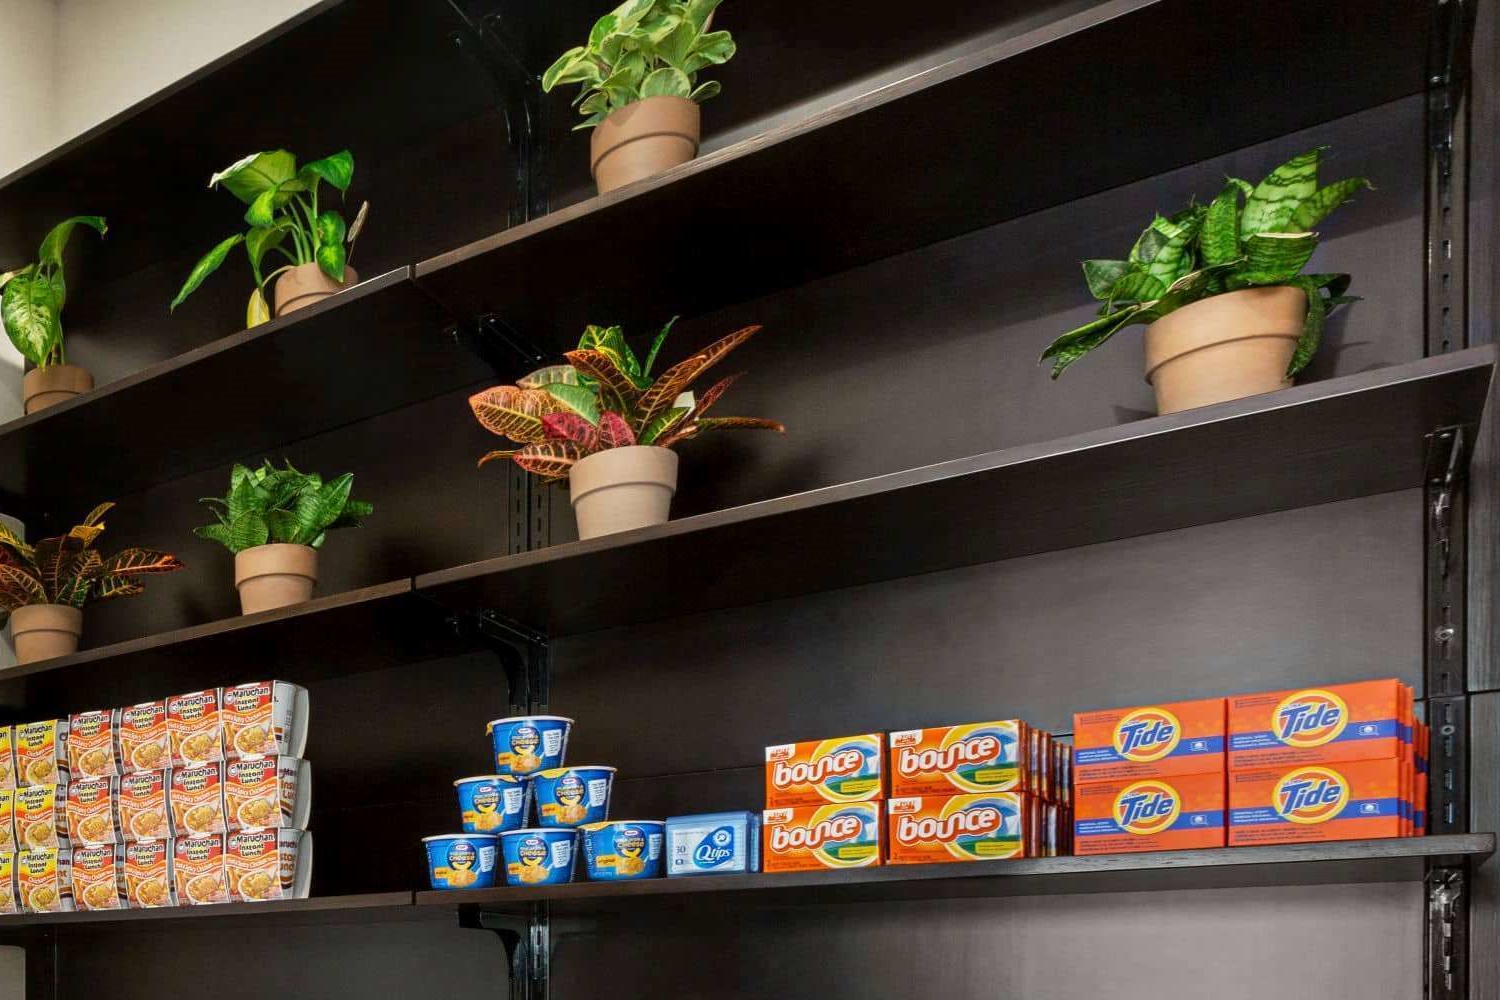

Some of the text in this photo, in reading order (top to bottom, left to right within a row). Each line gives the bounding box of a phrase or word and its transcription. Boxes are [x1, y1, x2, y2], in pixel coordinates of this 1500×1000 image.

[232, 687, 268, 698] Maruchan
[176, 695, 213, 708] Maruchan
[235, 697, 259, 705] Instant
[180, 706, 204, 714] Instant
[183, 712, 203, 720] Lunch
[1280, 702, 1340, 739] Tide
[24, 725, 53, 735] Maruchan
[1119, 719, 1173, 754] Tide
[899, 738, 997, 773] bounce
[237, 761, 273, 771] Maruchan
[774, 750, 858, 786] bounce
[239, 770, 264, 778] Instant
[1279, 779, 1341, 816] Tide
[1118, 792, 1173, 827] Tide
[898, 810, 997, 842] bounce
[237, 833, 274, 842] Maruchan
[772, 816, 855, 850] bounce
[239, 843, 264, 851] Instant
[242, 849, 261, 857] Lunch
